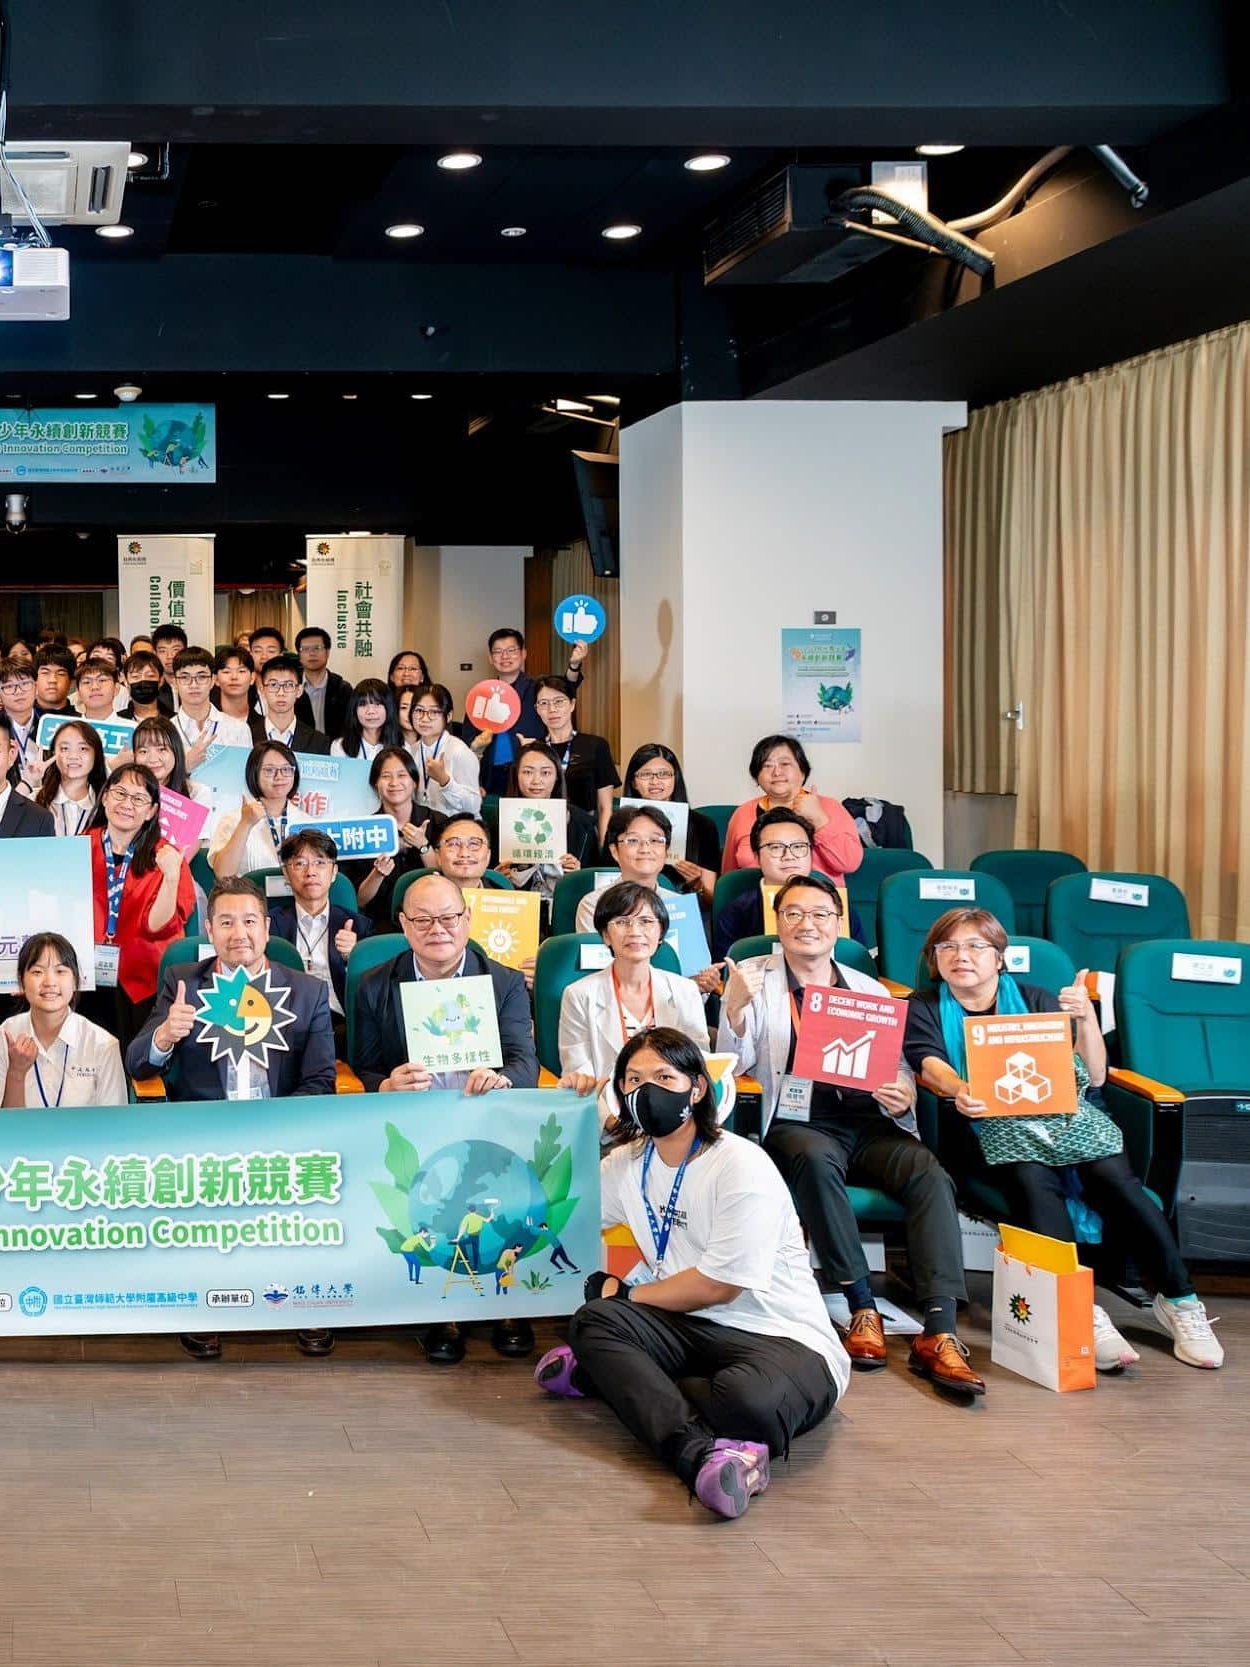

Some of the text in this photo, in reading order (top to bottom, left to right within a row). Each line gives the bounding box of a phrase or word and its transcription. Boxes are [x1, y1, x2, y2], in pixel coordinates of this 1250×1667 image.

[4, 443, 60, 454] Innovation
[62, 443, 128, 456] Competition
[337, 590, 349, 649] Inclusive
[354, 581, 373, 658] 社會共融
[810, 992, 823, 1012] 8
[829, 994, 896, 1014] DECENT WORK AND
[827, 1006, 898, 1027] ECONOMIC GROWTH
[972, 1024, 985, 1046] 9
[152, 1215, 340, 1250] Competition
[53, 1291, 198, 1306] 國立臺灣師範大學附屬高級中學
[211, 1293, 249, 1304] 承辦單位
